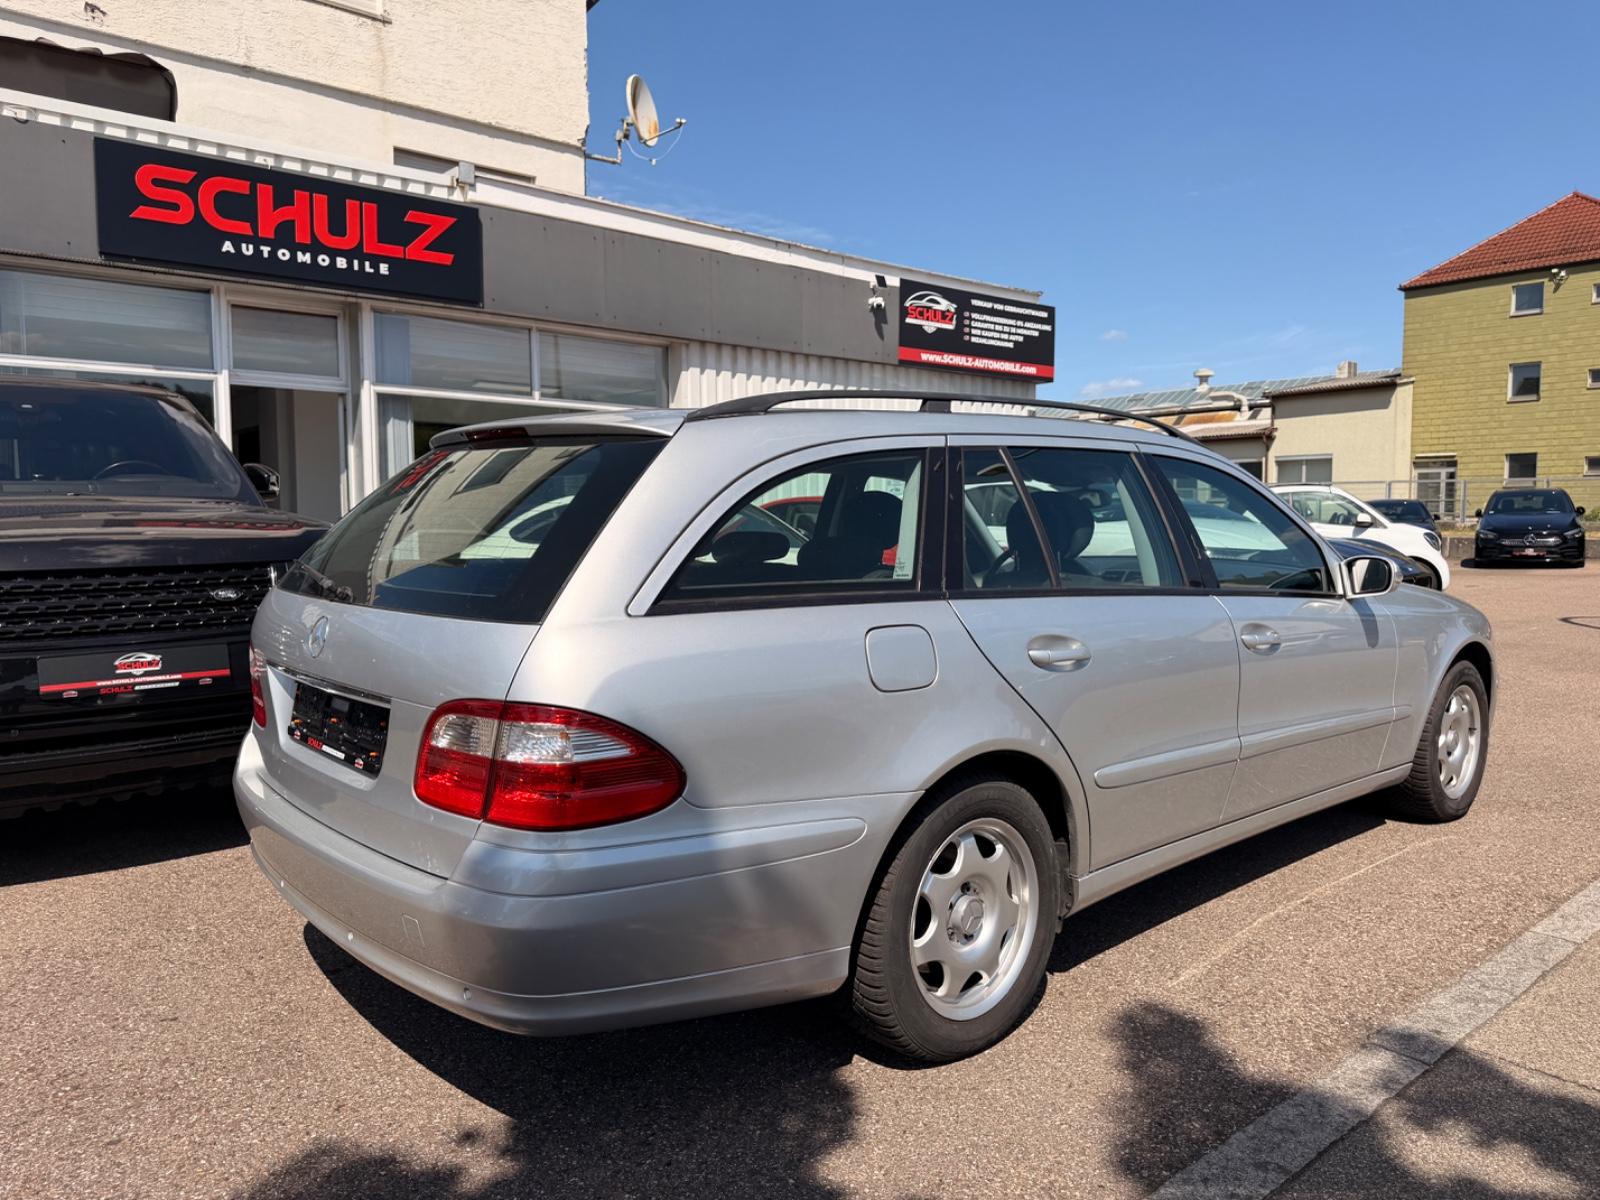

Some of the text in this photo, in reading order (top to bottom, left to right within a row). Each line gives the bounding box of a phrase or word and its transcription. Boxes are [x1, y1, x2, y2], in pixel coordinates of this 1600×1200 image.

[129, 163, 457, 266] SCHULZ
[221, 240, 390, 276] AUTOMOBILE
[907, 306, 955, 325] SCHULZ
[920, 352, 1037, 374] www.SCHULZ-AUTOMOBILE.com
[115, 659, 162, 670] SCHULZ
[99, 685, 134, 696] SCHULZ
